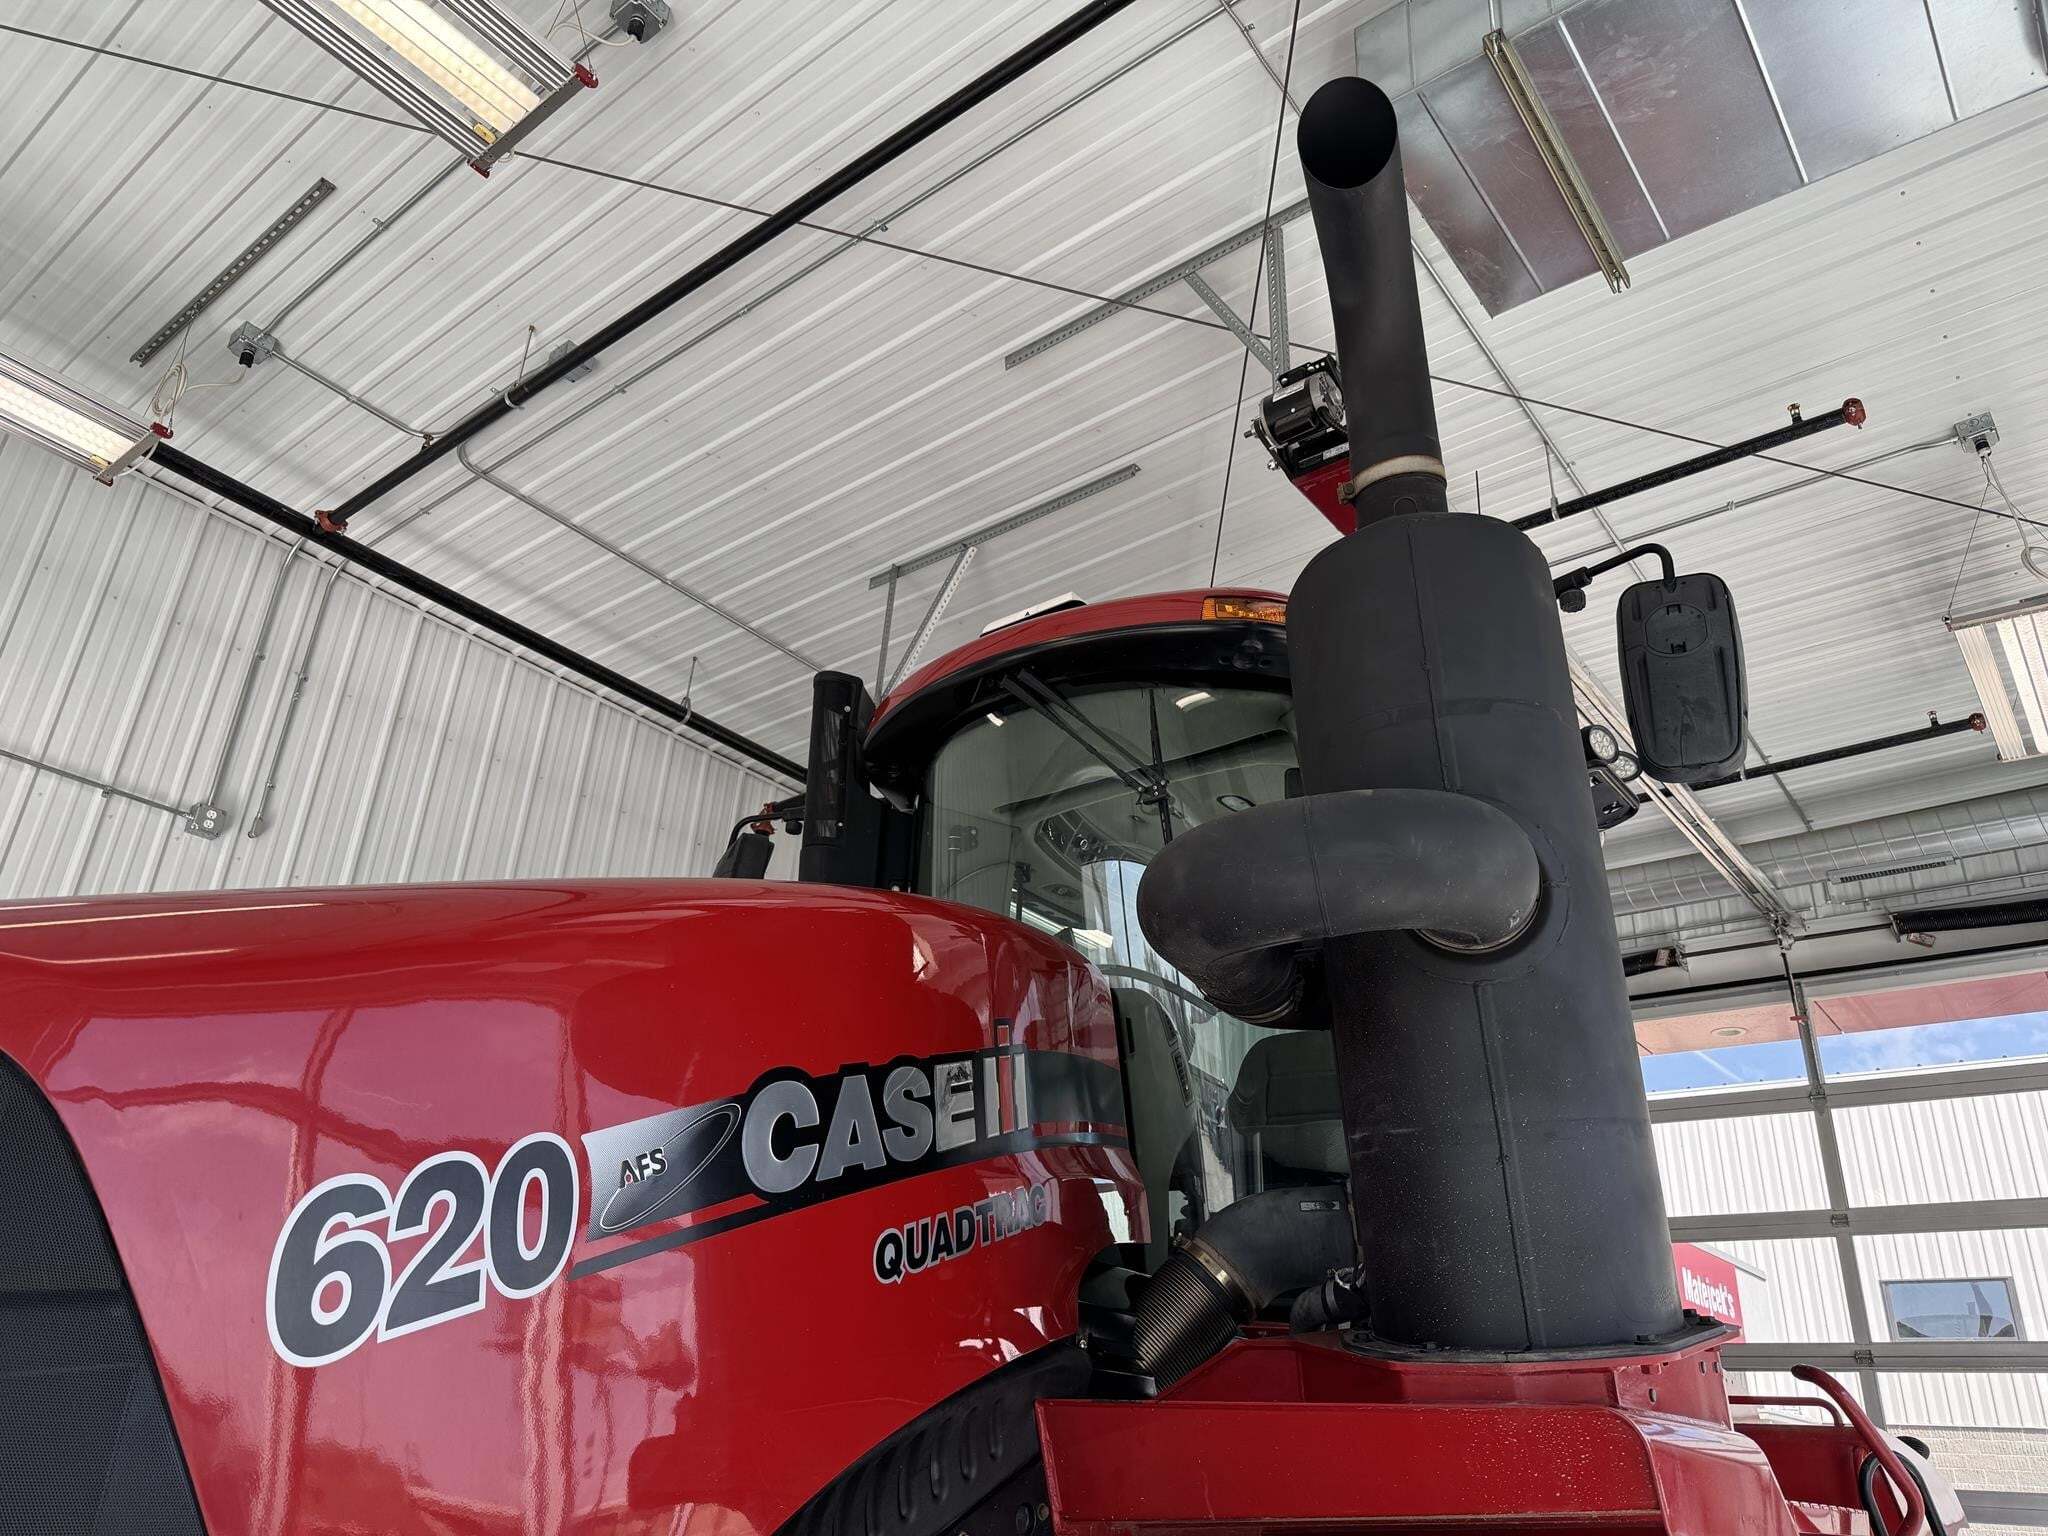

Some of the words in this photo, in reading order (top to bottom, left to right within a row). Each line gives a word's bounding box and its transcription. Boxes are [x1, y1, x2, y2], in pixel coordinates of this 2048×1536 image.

[619, 1148, 668, 1189] AFS
[266, 1132, 578, 1369] 620
[872, 1183, 1048, 1284] QUADTRAC
